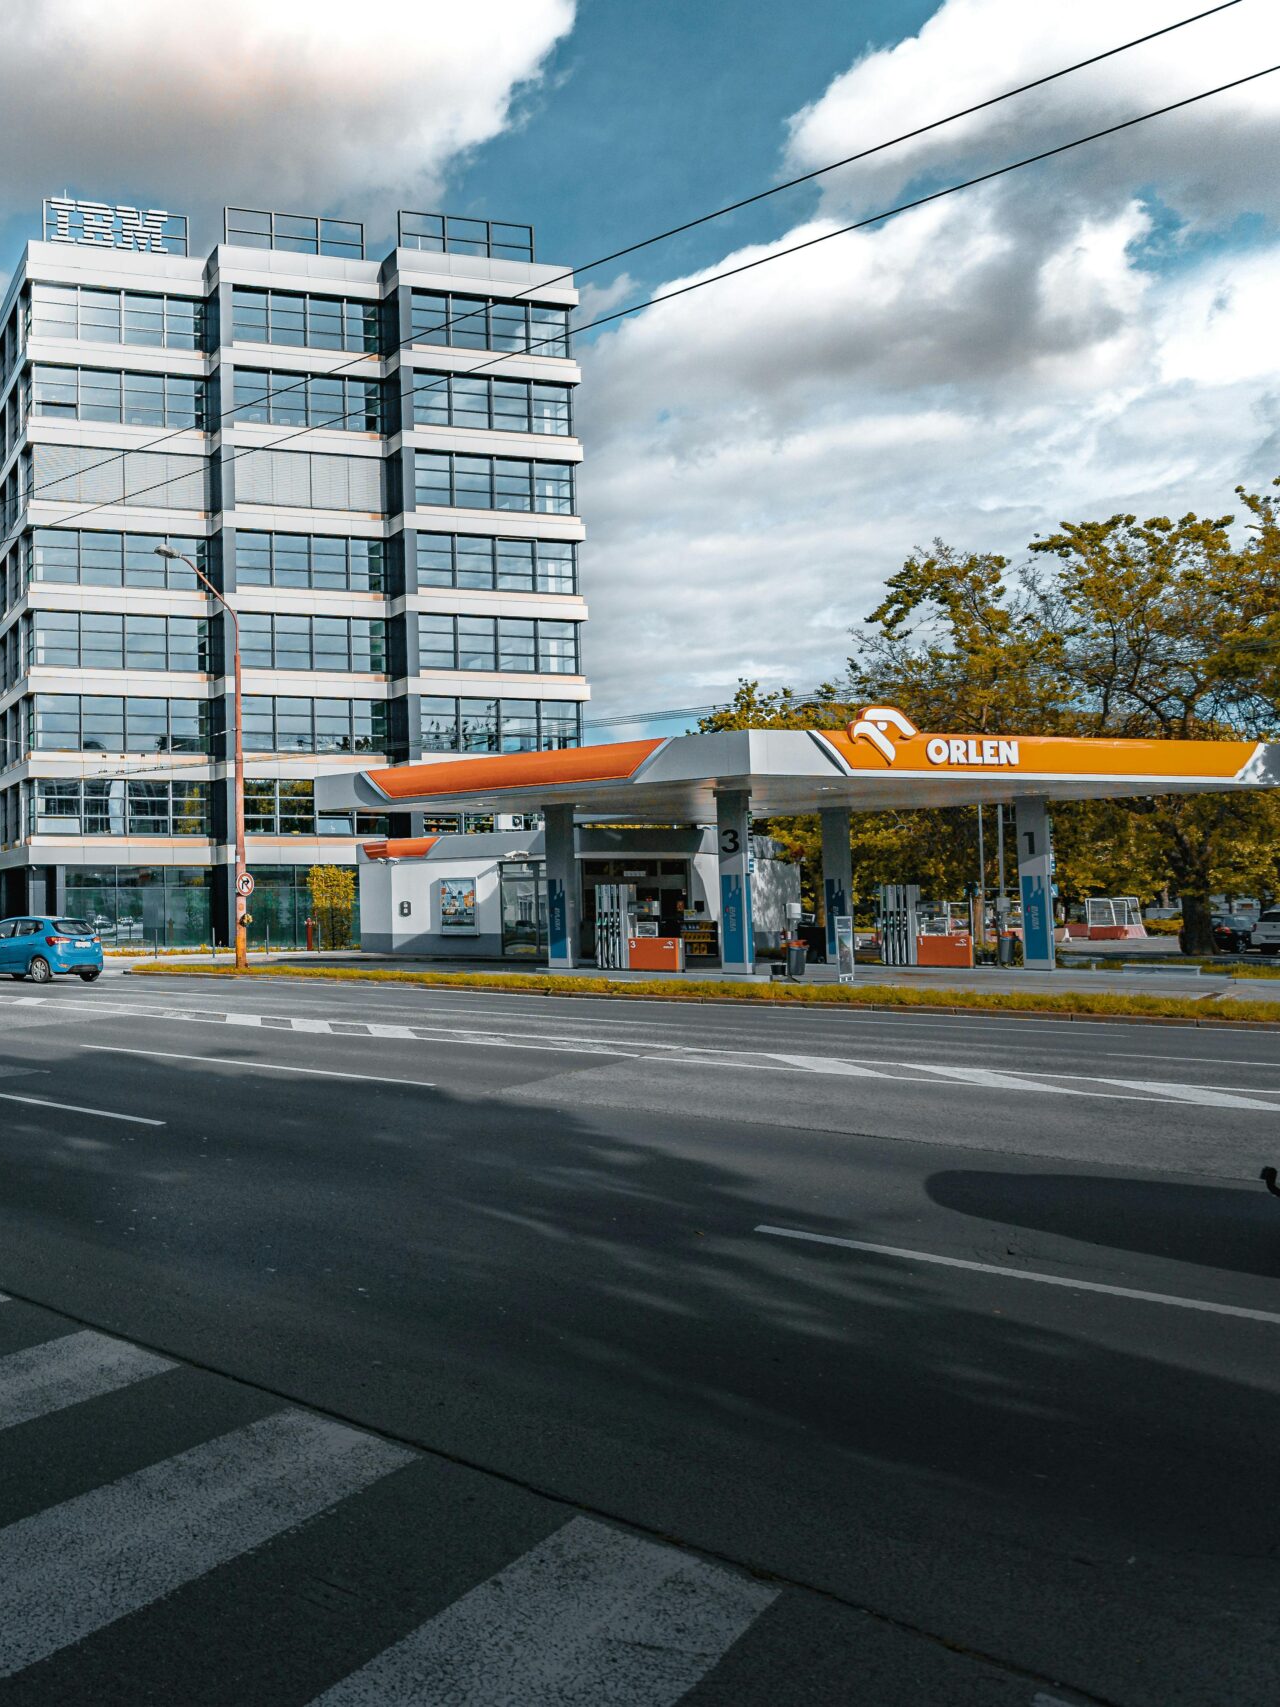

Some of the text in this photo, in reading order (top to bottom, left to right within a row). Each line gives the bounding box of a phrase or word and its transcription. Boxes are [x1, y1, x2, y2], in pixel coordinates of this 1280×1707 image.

[50, 197, 168, 253] IBM
[926, 738, 1019, 765] ORLEN
[721, 829, 740, 853] 3
[1023, 831, 1035, 854] 1
[630, 940, 636, 948] 3
